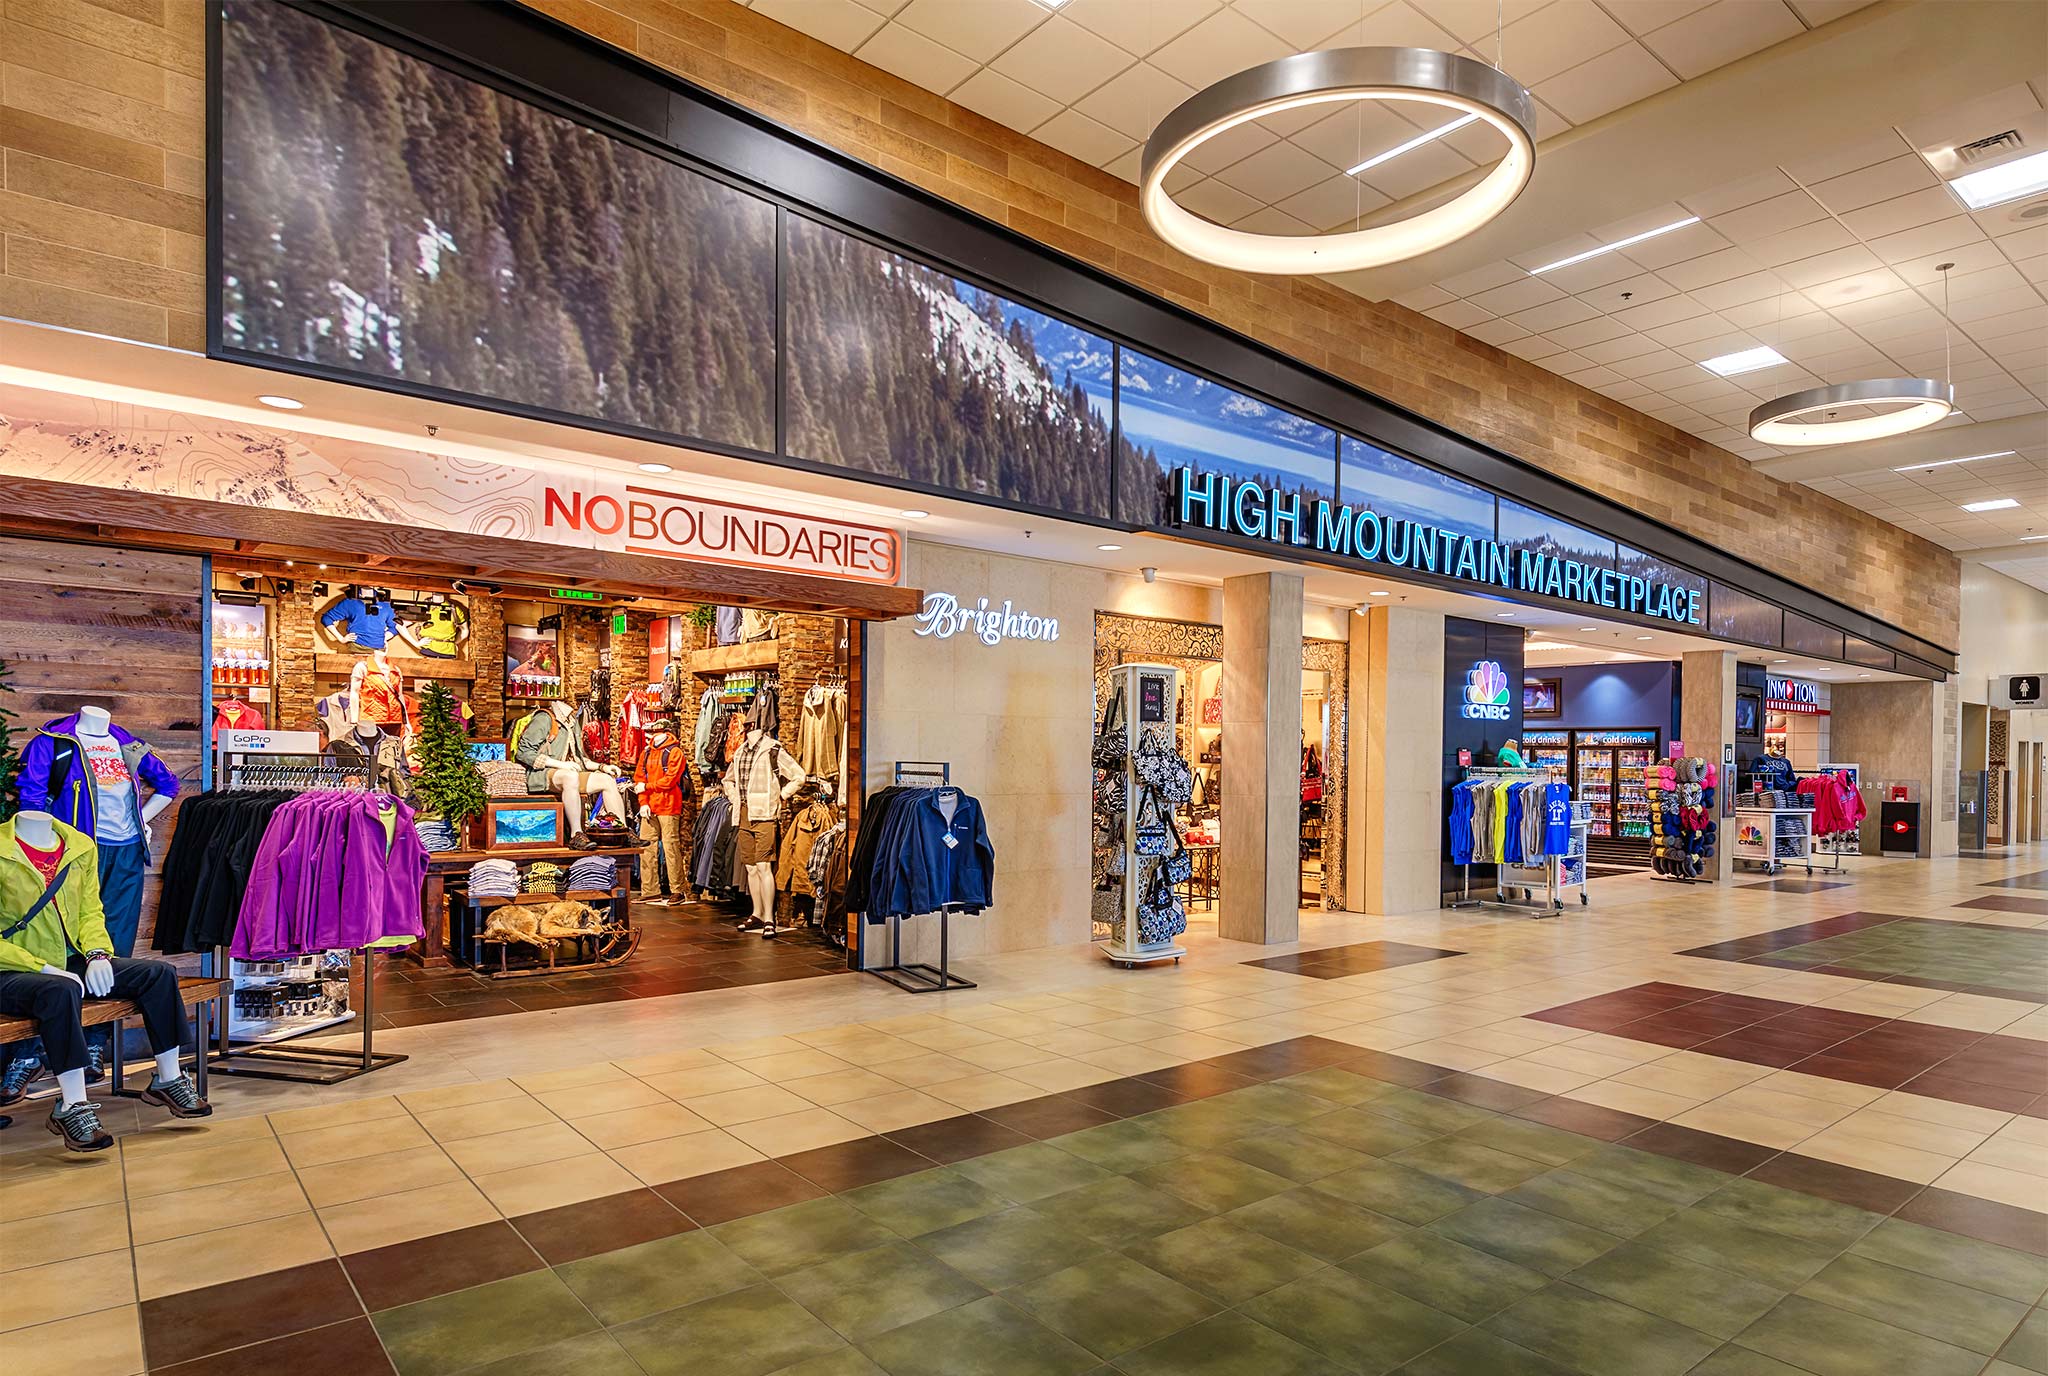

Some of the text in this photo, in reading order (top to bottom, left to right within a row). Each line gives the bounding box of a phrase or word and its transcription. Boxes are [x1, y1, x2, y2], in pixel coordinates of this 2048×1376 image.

[544, 486, 894, 573] NO BOUNDARIES
[1180, 466, 1701, 625] HIGH MOUNTAIN MARKETPLACE
[913, 592, 1060, 646] Brighton
[1468, 704, 1511, 720] CNBC
[233, 734, 271, 743] GoPro
[1538, 735, 1561, 744] drinks
[1602, 735, 1647, 744] cold drinks
[1738, 839, 1763, 847] CNBC
